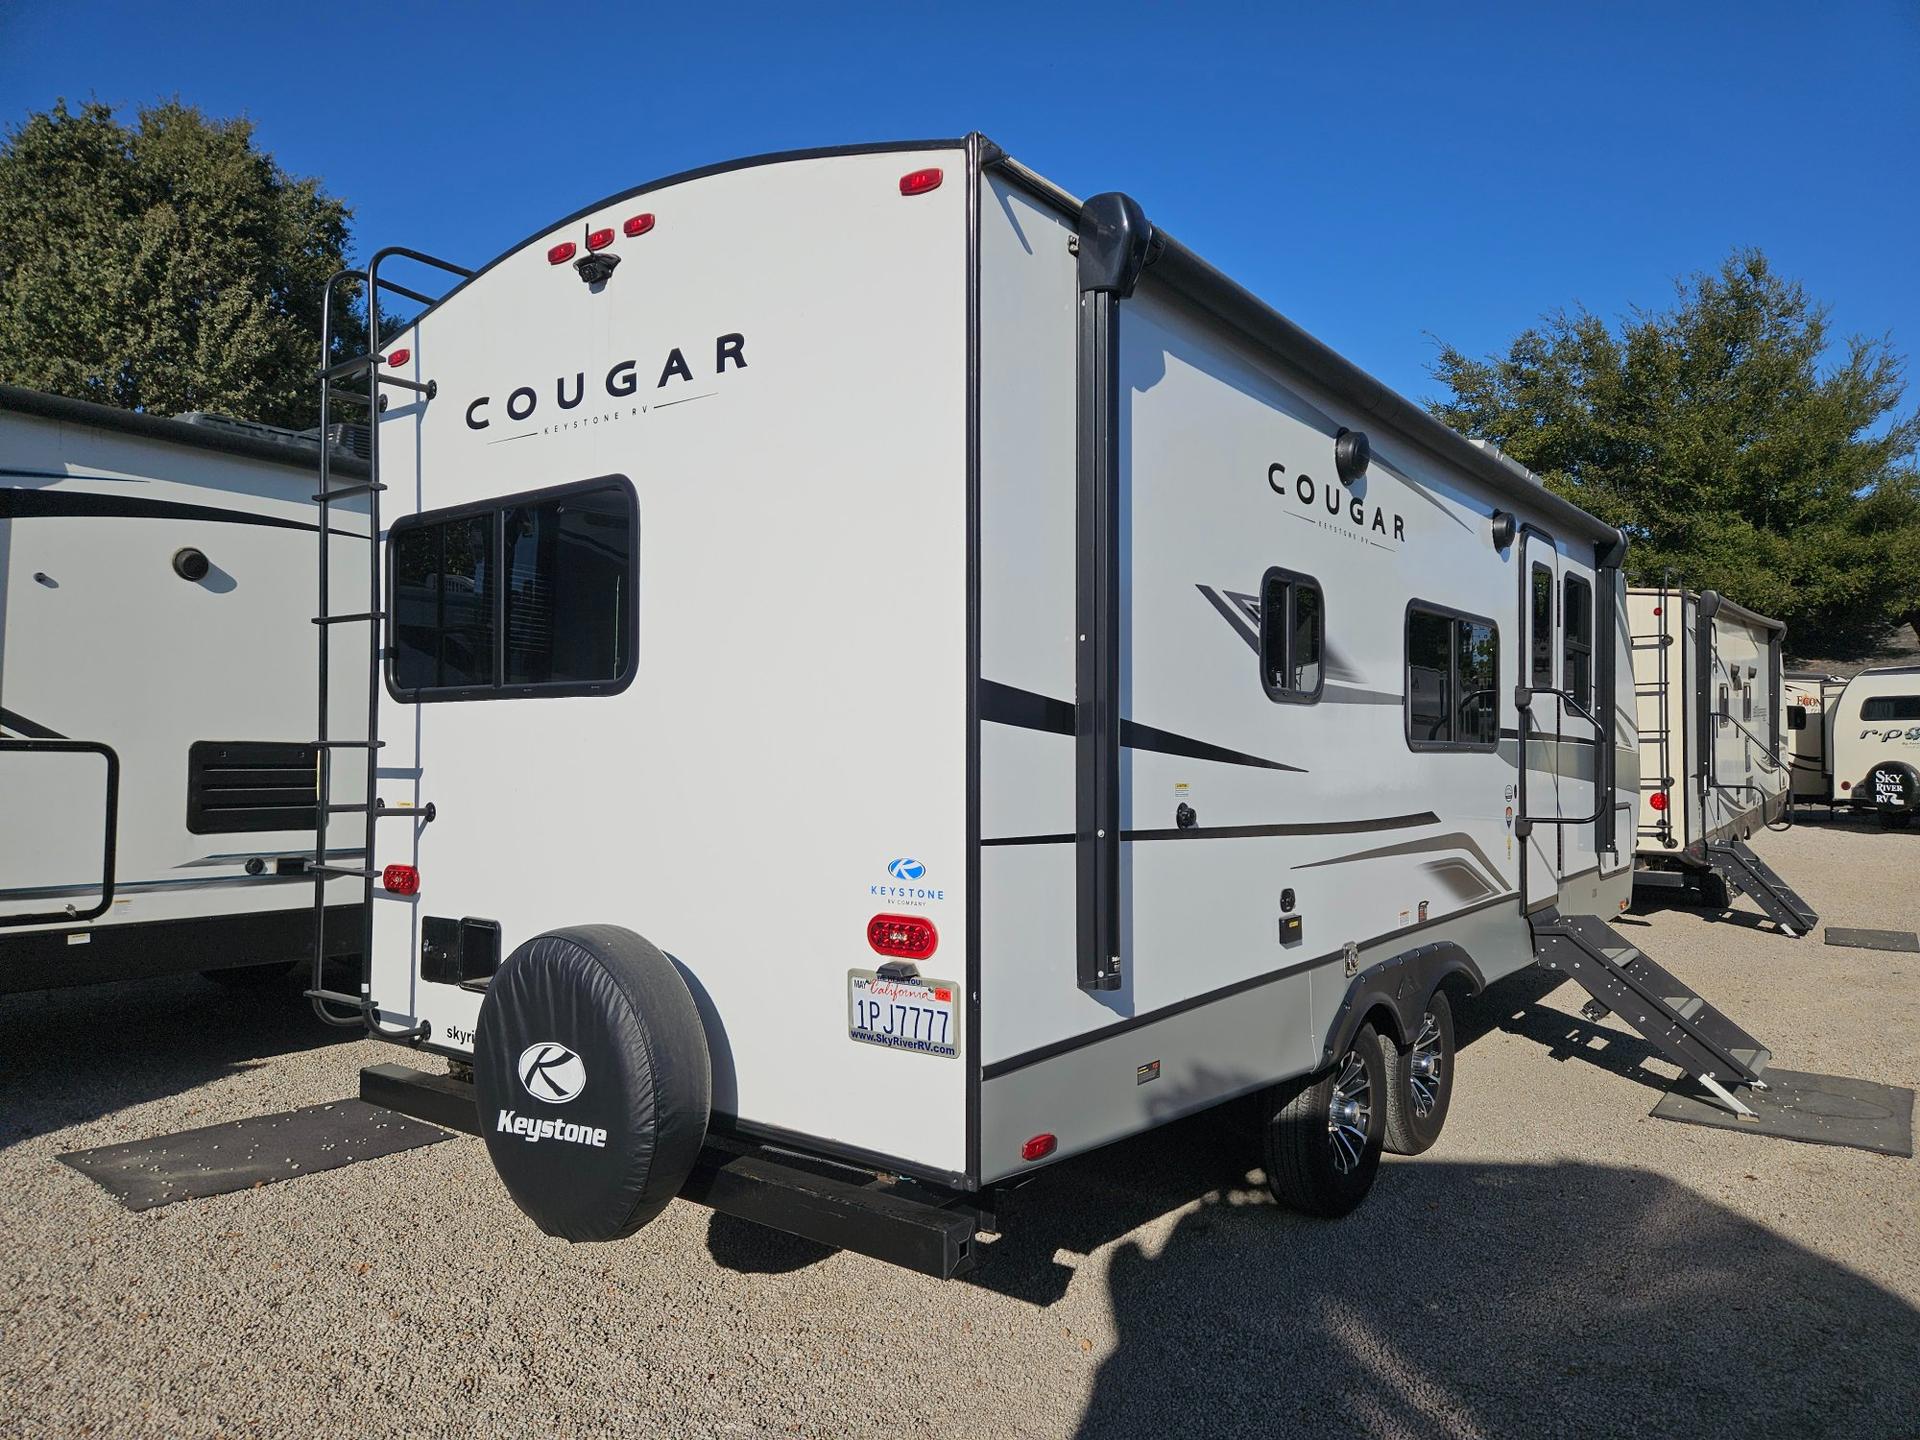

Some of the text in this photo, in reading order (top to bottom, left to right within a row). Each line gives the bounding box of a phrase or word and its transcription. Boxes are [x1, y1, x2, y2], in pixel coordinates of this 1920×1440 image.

[465, 332, 748, 430] COUGAR
[543, 405, 649, 435] KEYSTONE RV
[1268, 462, 1405, 542] COUGAR
[1875, 770, 1903, 783] SKY
[1876, 783, 1904, 792] RIVER
[1876, 794, 1889, 803] RV
[871, 885, 944, 900] KEYSTONE
[853, 979, 867, 989] MAY
[870, 978, 929, 1001] California
[857, 999, 949, 1043] 1PJ7777
[850, 1030, 956, 1056] www.SkyRiverRV.com
[496, 1109, 608, 1148] Keystone
